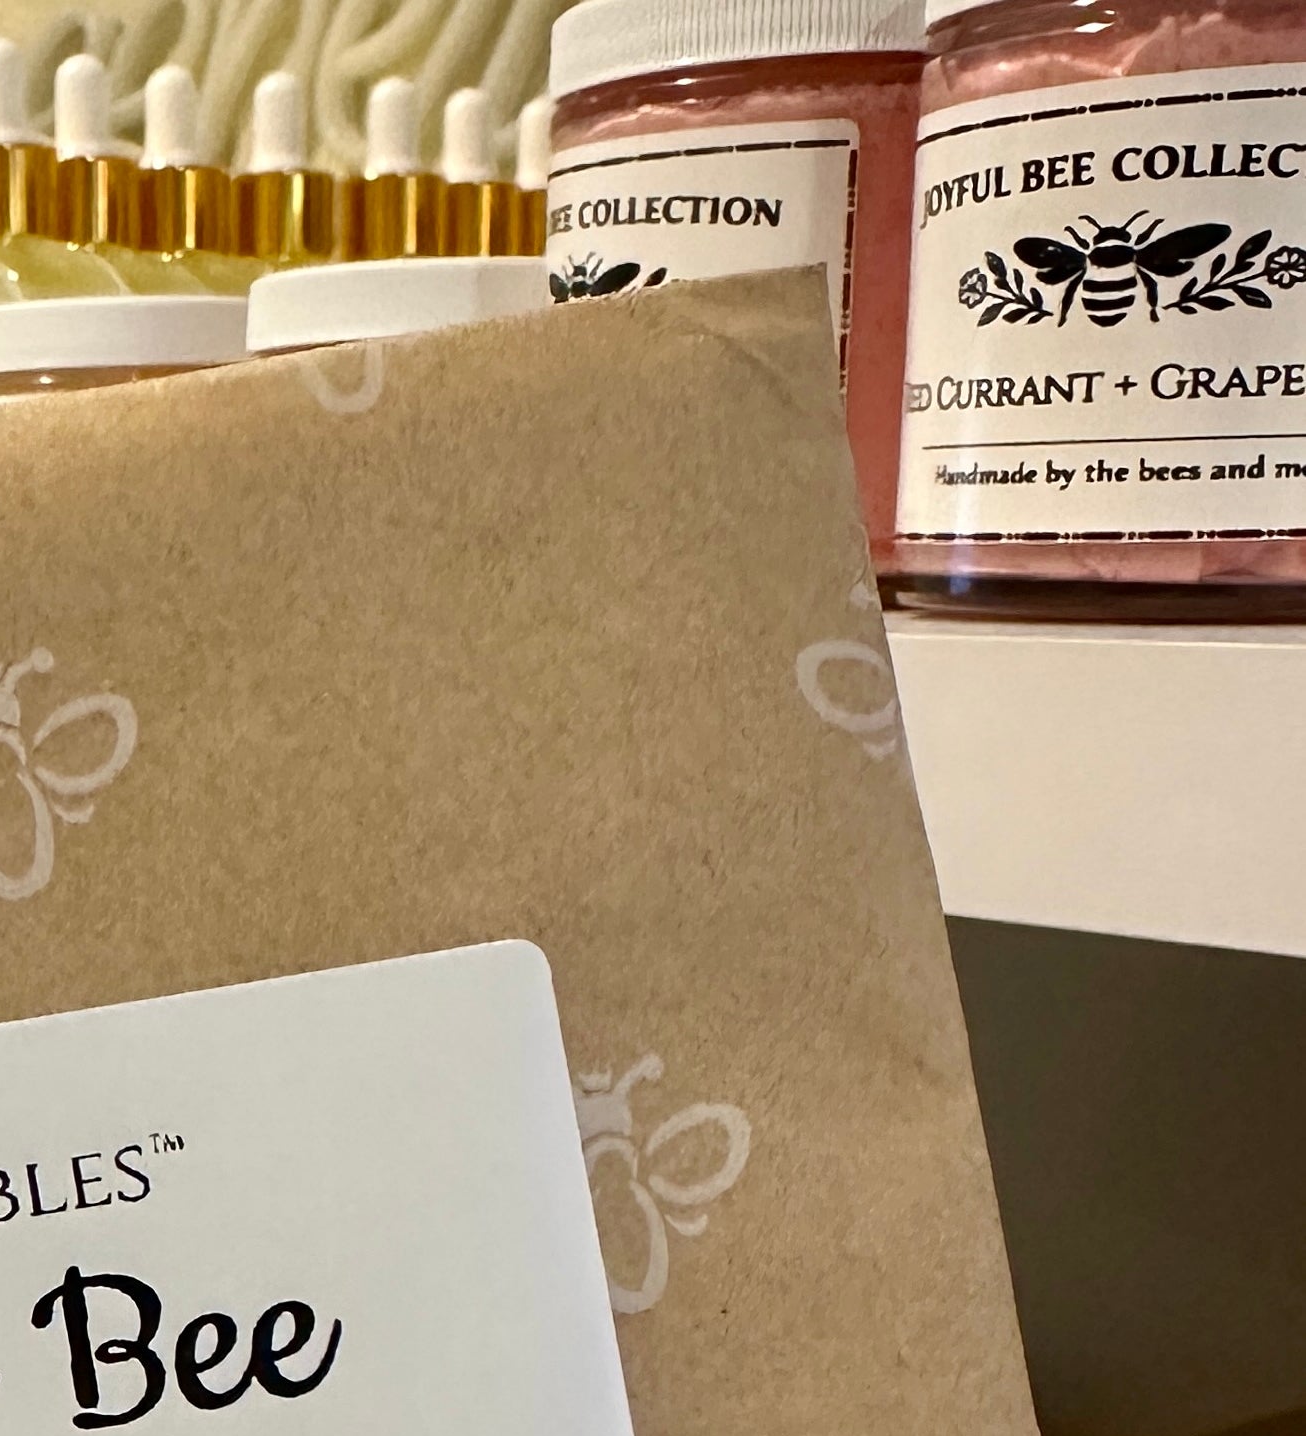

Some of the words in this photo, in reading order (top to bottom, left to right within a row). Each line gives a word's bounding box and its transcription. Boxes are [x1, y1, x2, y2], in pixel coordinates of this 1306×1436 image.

[920, 166, 1012, 229] JOYFUL
[1020, 151, 1095, 193] BEE
[1111, 143, 1306, 182] COLLEC
[578, 195, 783, 229] COLLECTION
[937, 371, 1105, 410] CURRANT
[1150, 363, 1306, 399] GRAPE
[935, 461, 1038, 485] Handmade
[1045, 459, 1076, 490] by
[1084, 459, 1130, 483] the
[1139, 457, 1201, 482] bees
[1209, 453, 1265, 480] and
[31, 1266, 343, 1430] Bee
